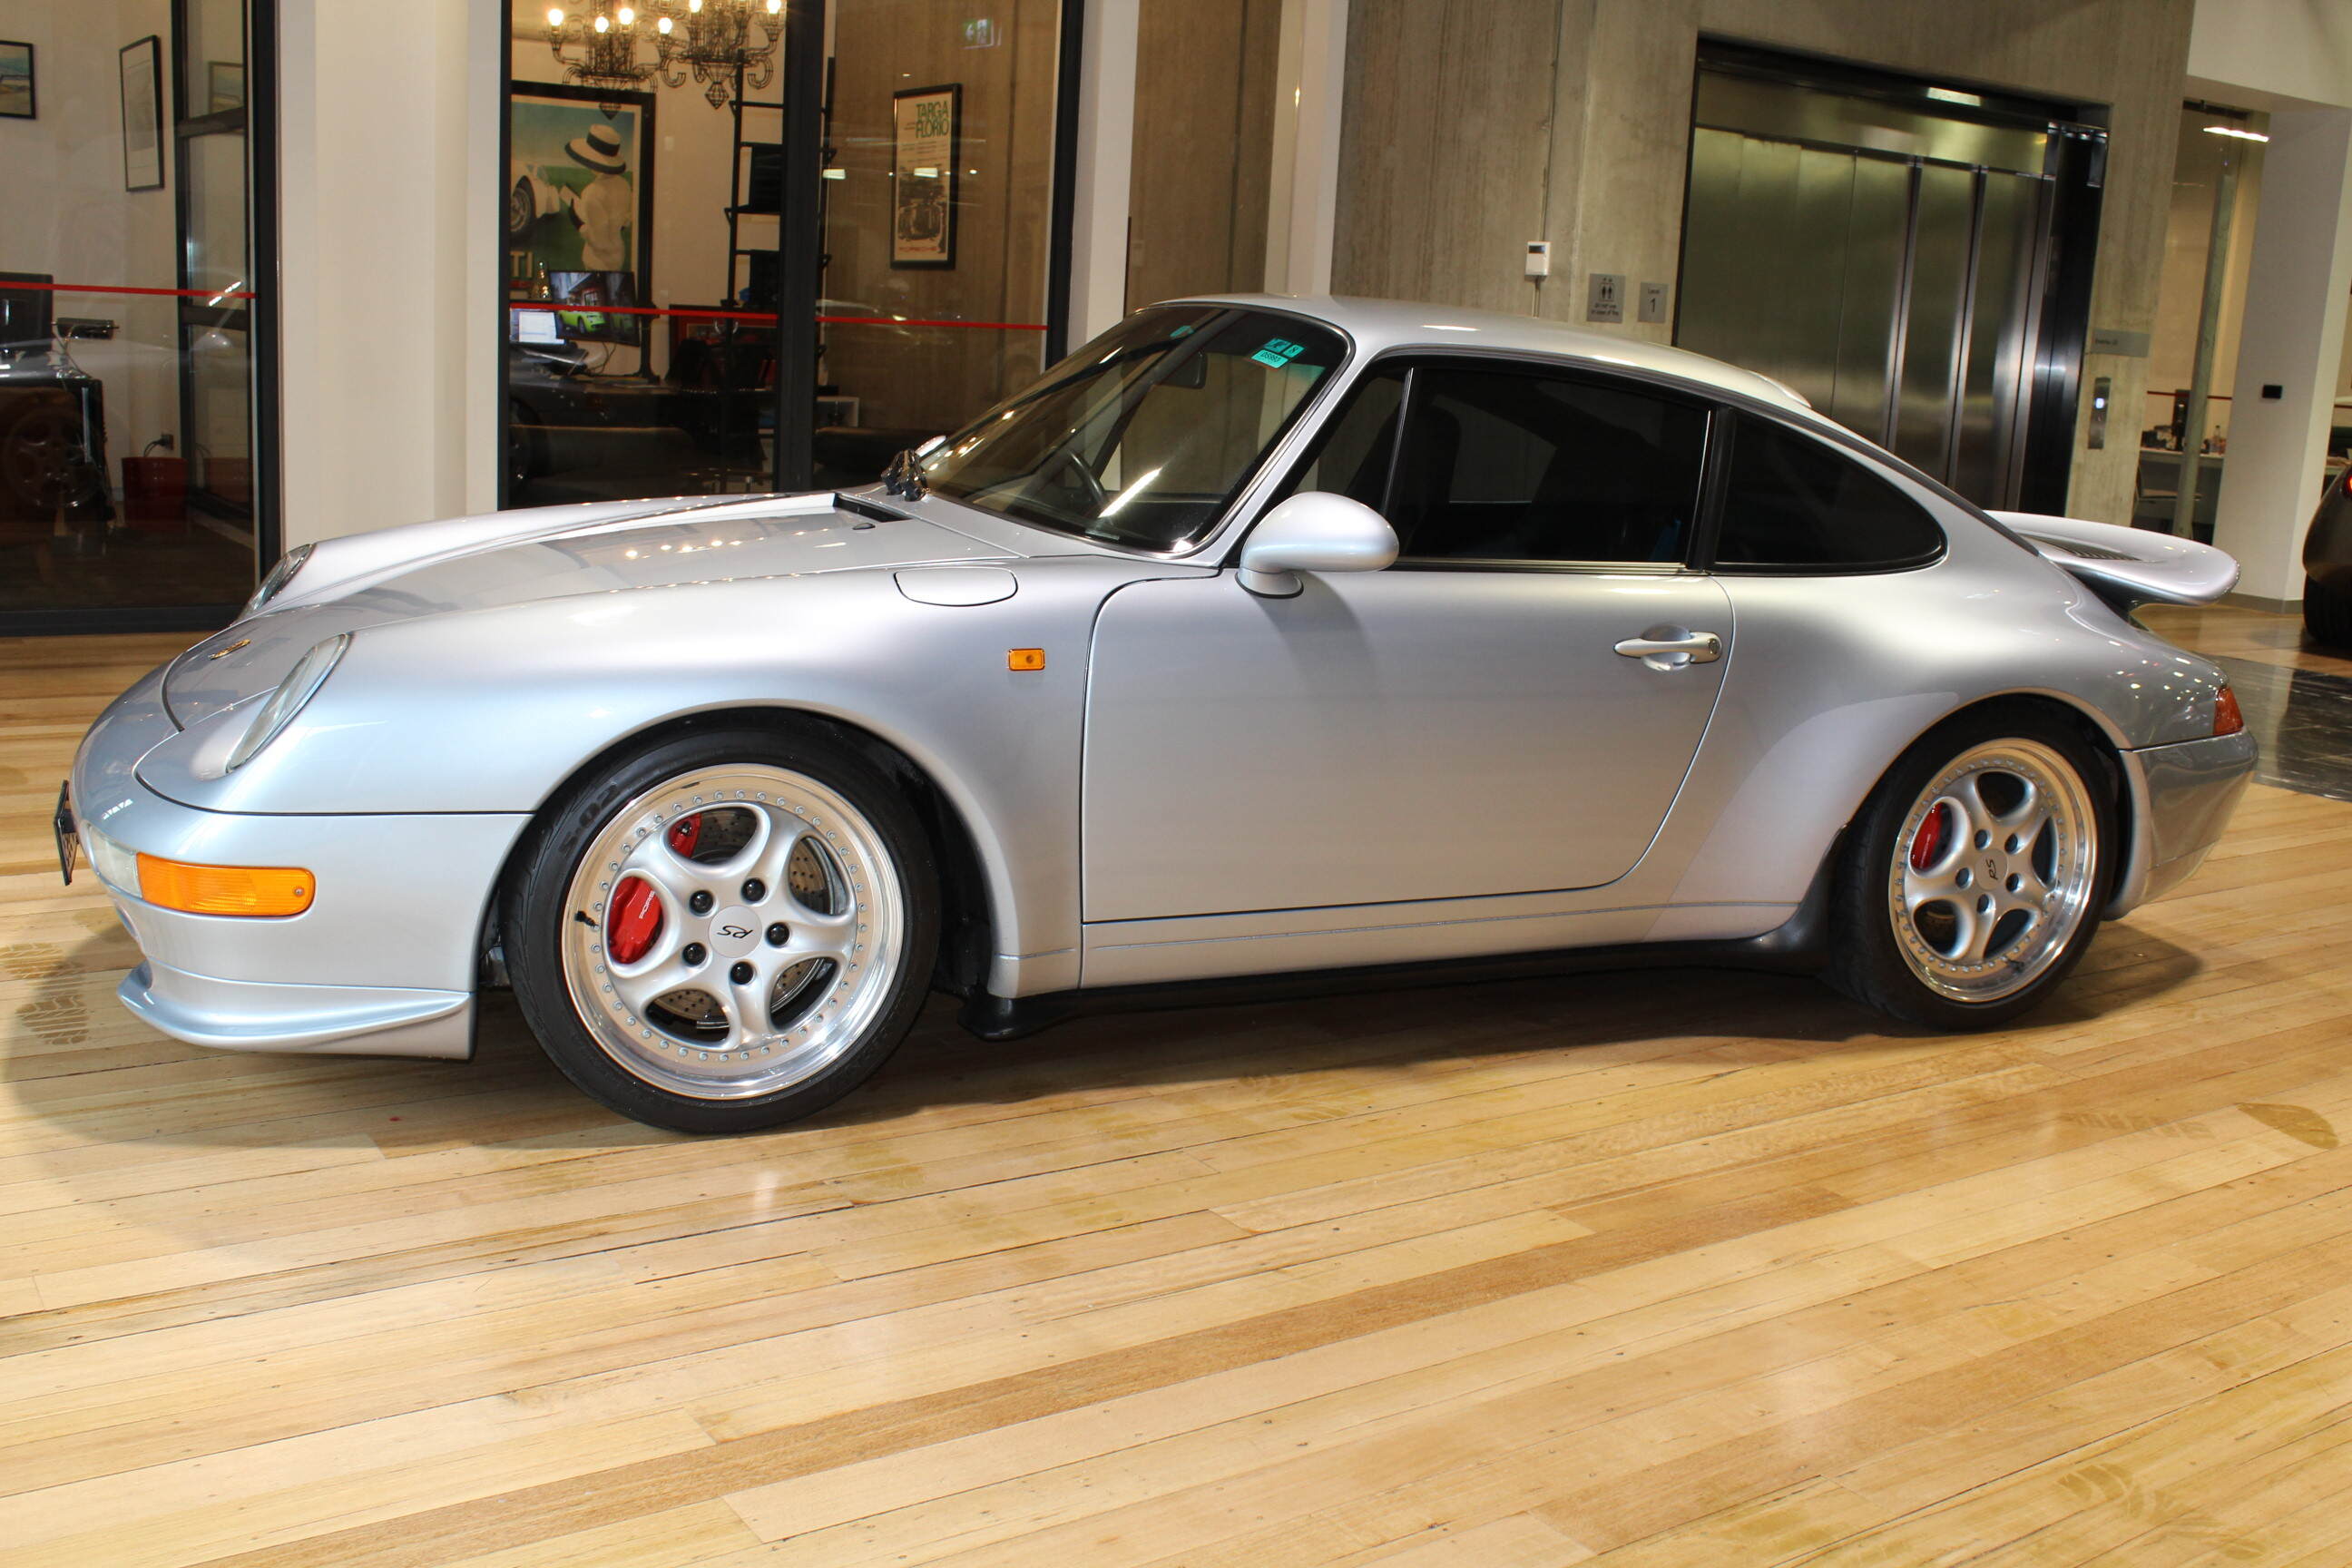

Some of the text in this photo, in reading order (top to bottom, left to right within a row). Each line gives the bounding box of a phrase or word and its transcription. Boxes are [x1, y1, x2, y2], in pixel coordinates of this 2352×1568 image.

[915, 101, 949, 117] TARGA
[915, 118, 949, 138] FLORIO
[1650, 298, 1656, 313] 1
[1985, 858, 1998, 880] RS
[716, 925, 754, 939] RS
